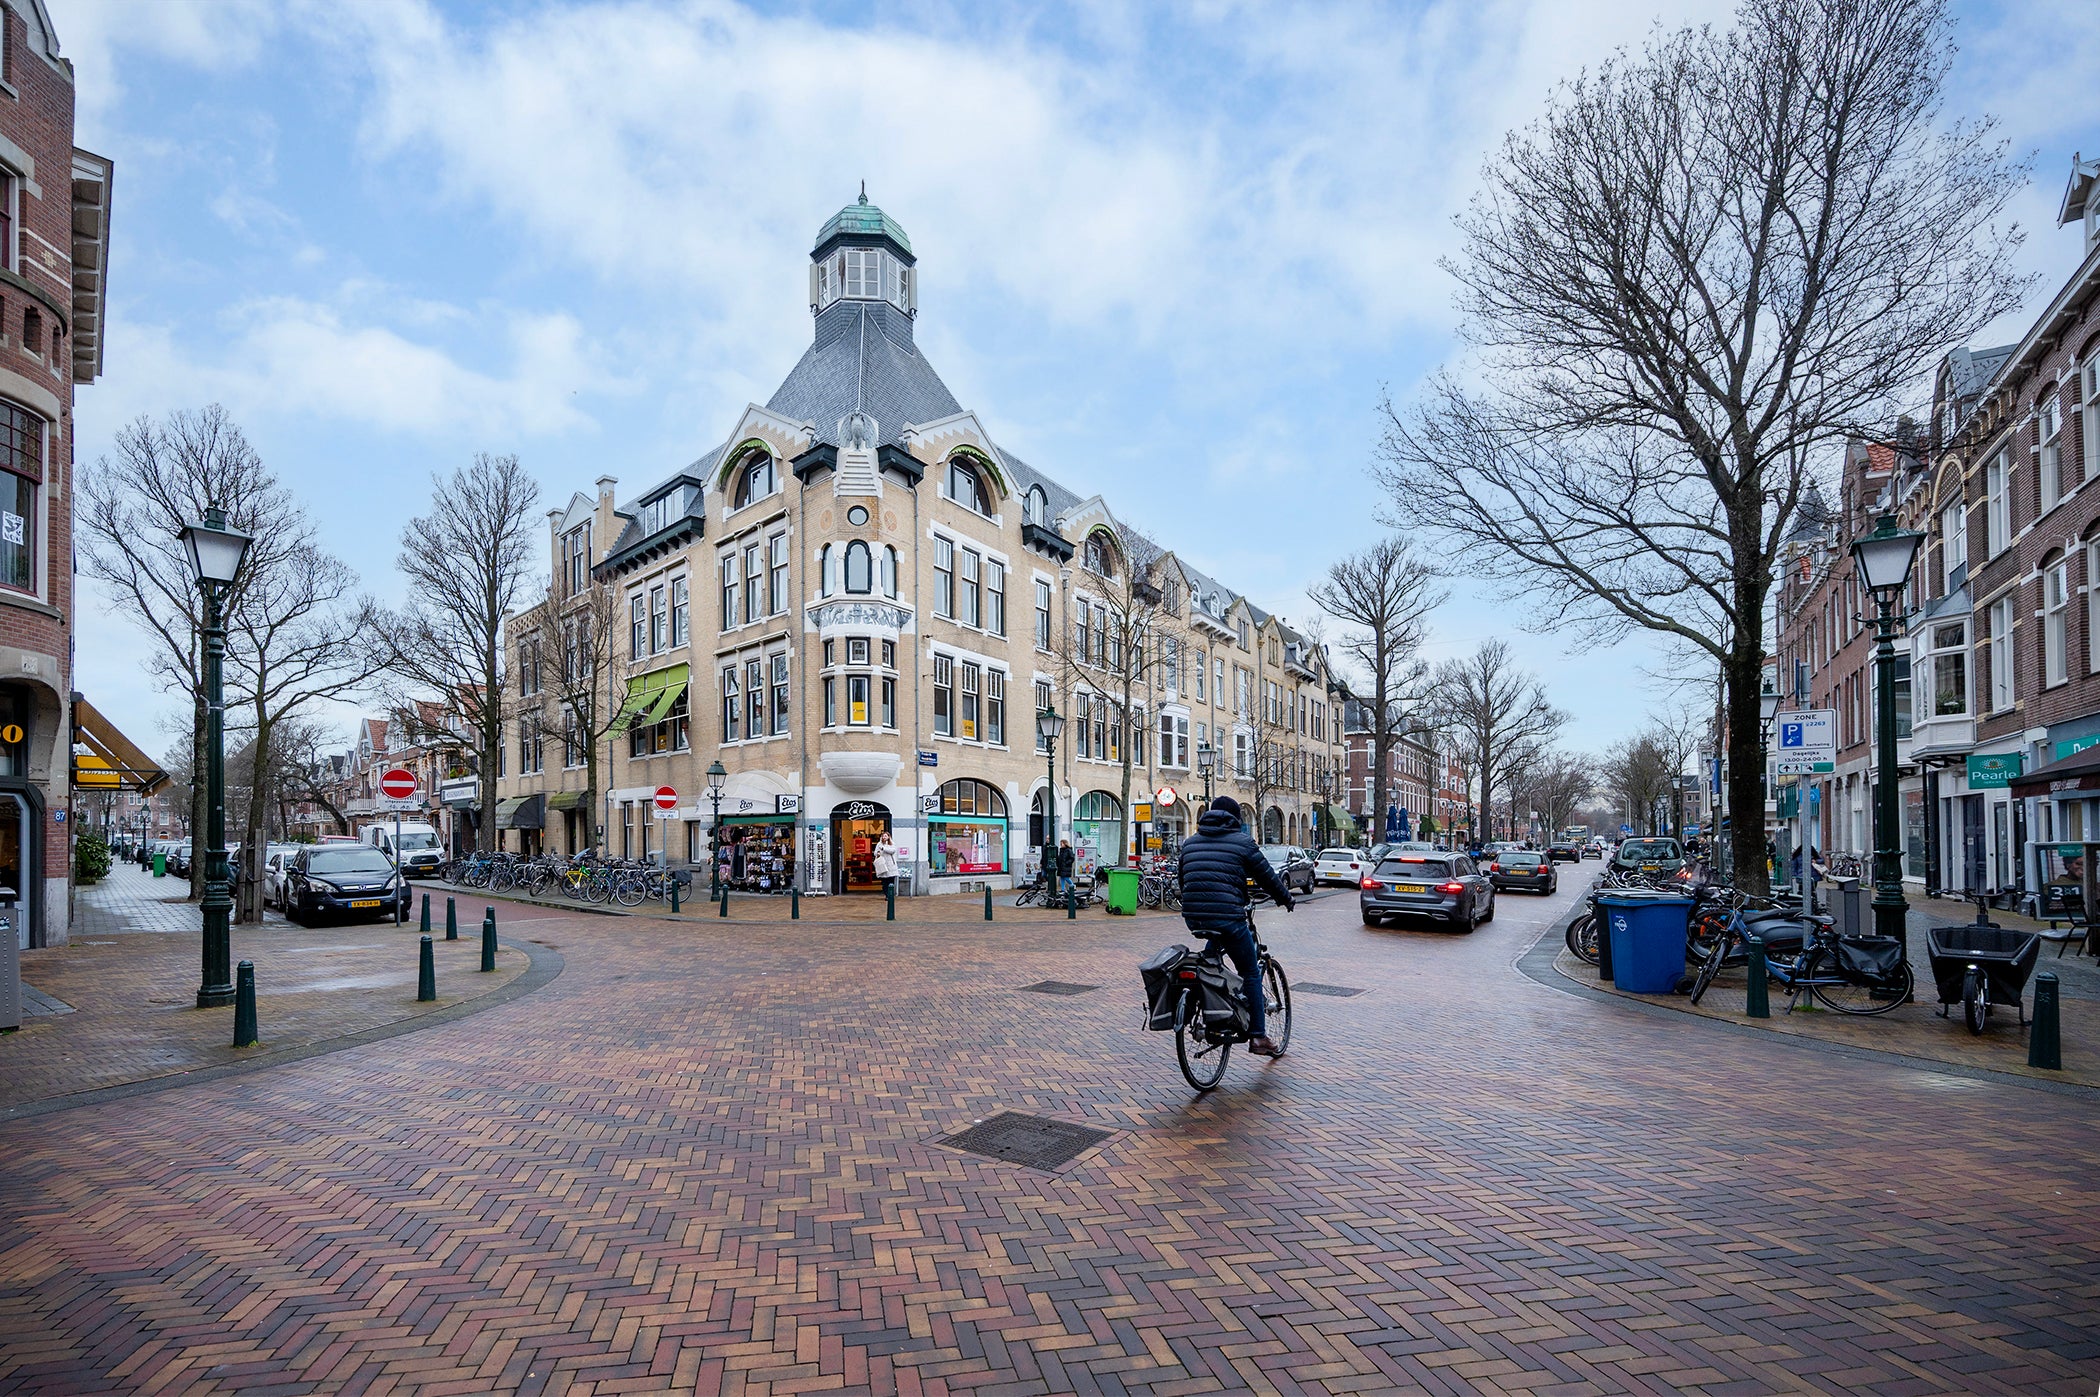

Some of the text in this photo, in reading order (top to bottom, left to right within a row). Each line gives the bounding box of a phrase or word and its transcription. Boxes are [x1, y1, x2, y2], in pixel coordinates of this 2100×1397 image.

[1788, 725, 1798, 736] P
[1972, 770, 2017, 780] Pearle
[739, 800, 754, 812] Etos
[781, 797, 797, 810] Etos
[925, 798, 939, 811] Etos
[55, 811, 66, 821] 87
[848, 802, 875, 821] Etos
